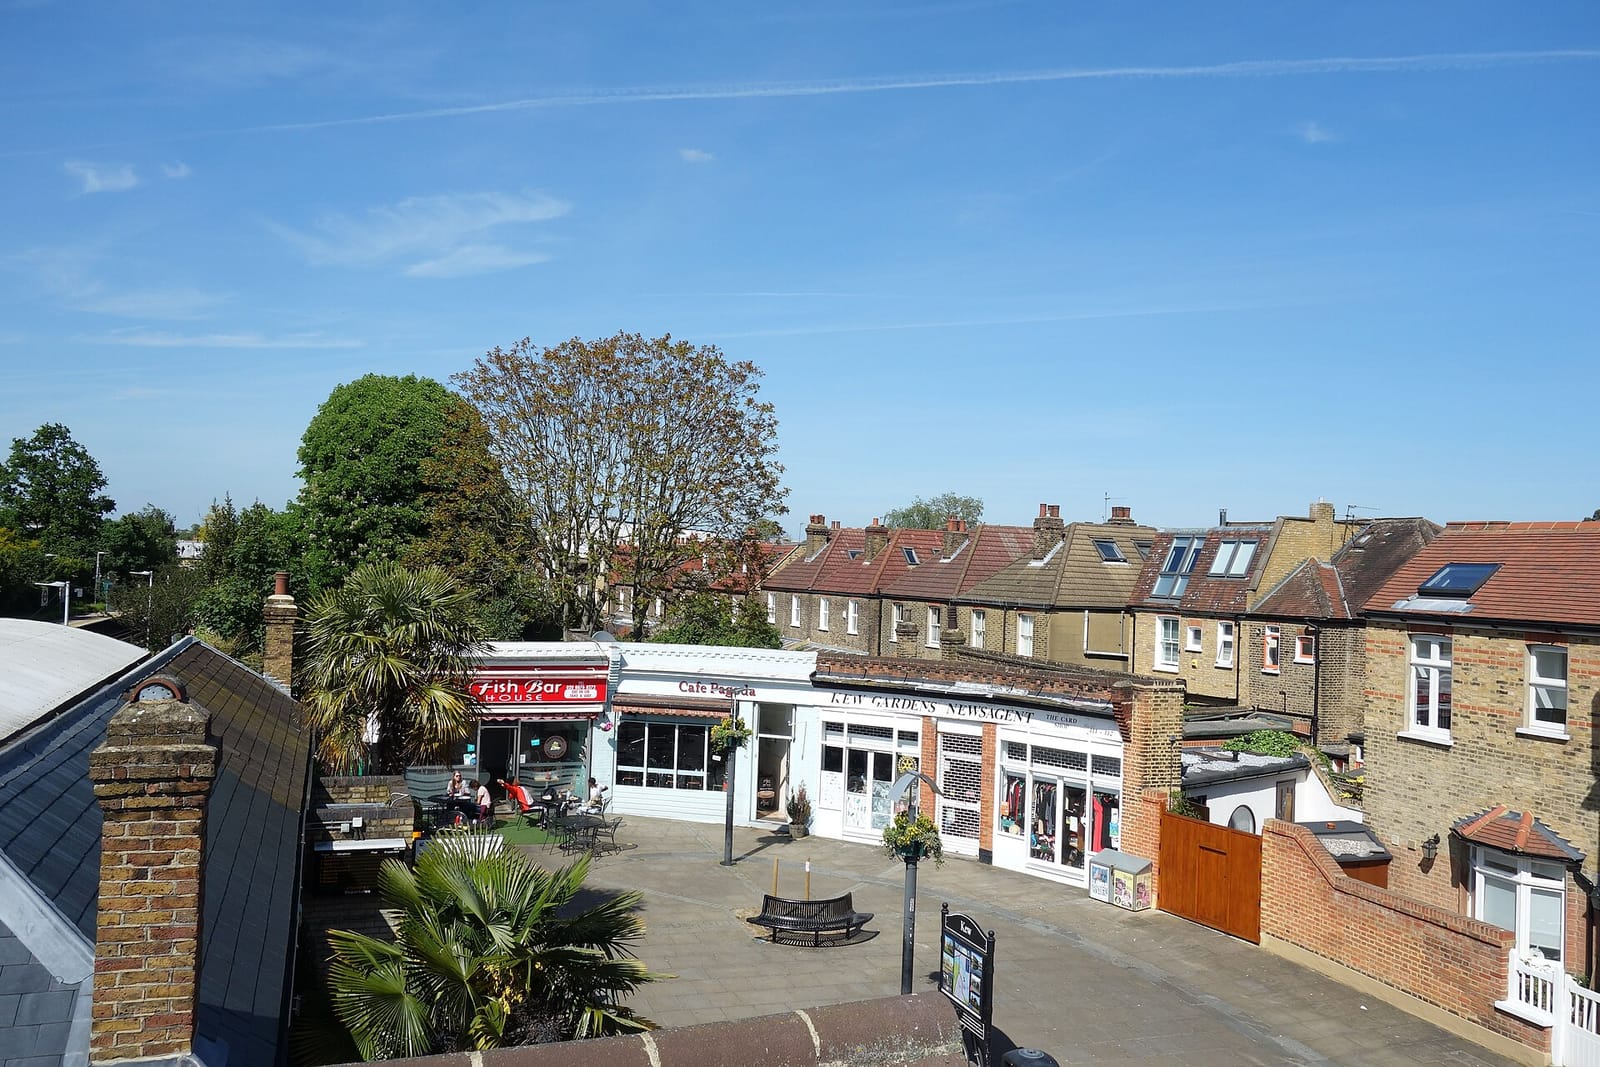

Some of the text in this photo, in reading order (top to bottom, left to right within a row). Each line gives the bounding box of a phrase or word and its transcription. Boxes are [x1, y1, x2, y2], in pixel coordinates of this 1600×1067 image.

[469, 680, 518, 695] Fish
[524, 680, 562, 694] Bar
[679, 681, 707, 693] Cafe
[831, 692, 1034, 723] KEW GARDENS NEWSAGENT
[960, 920, 972, 935] Kew
